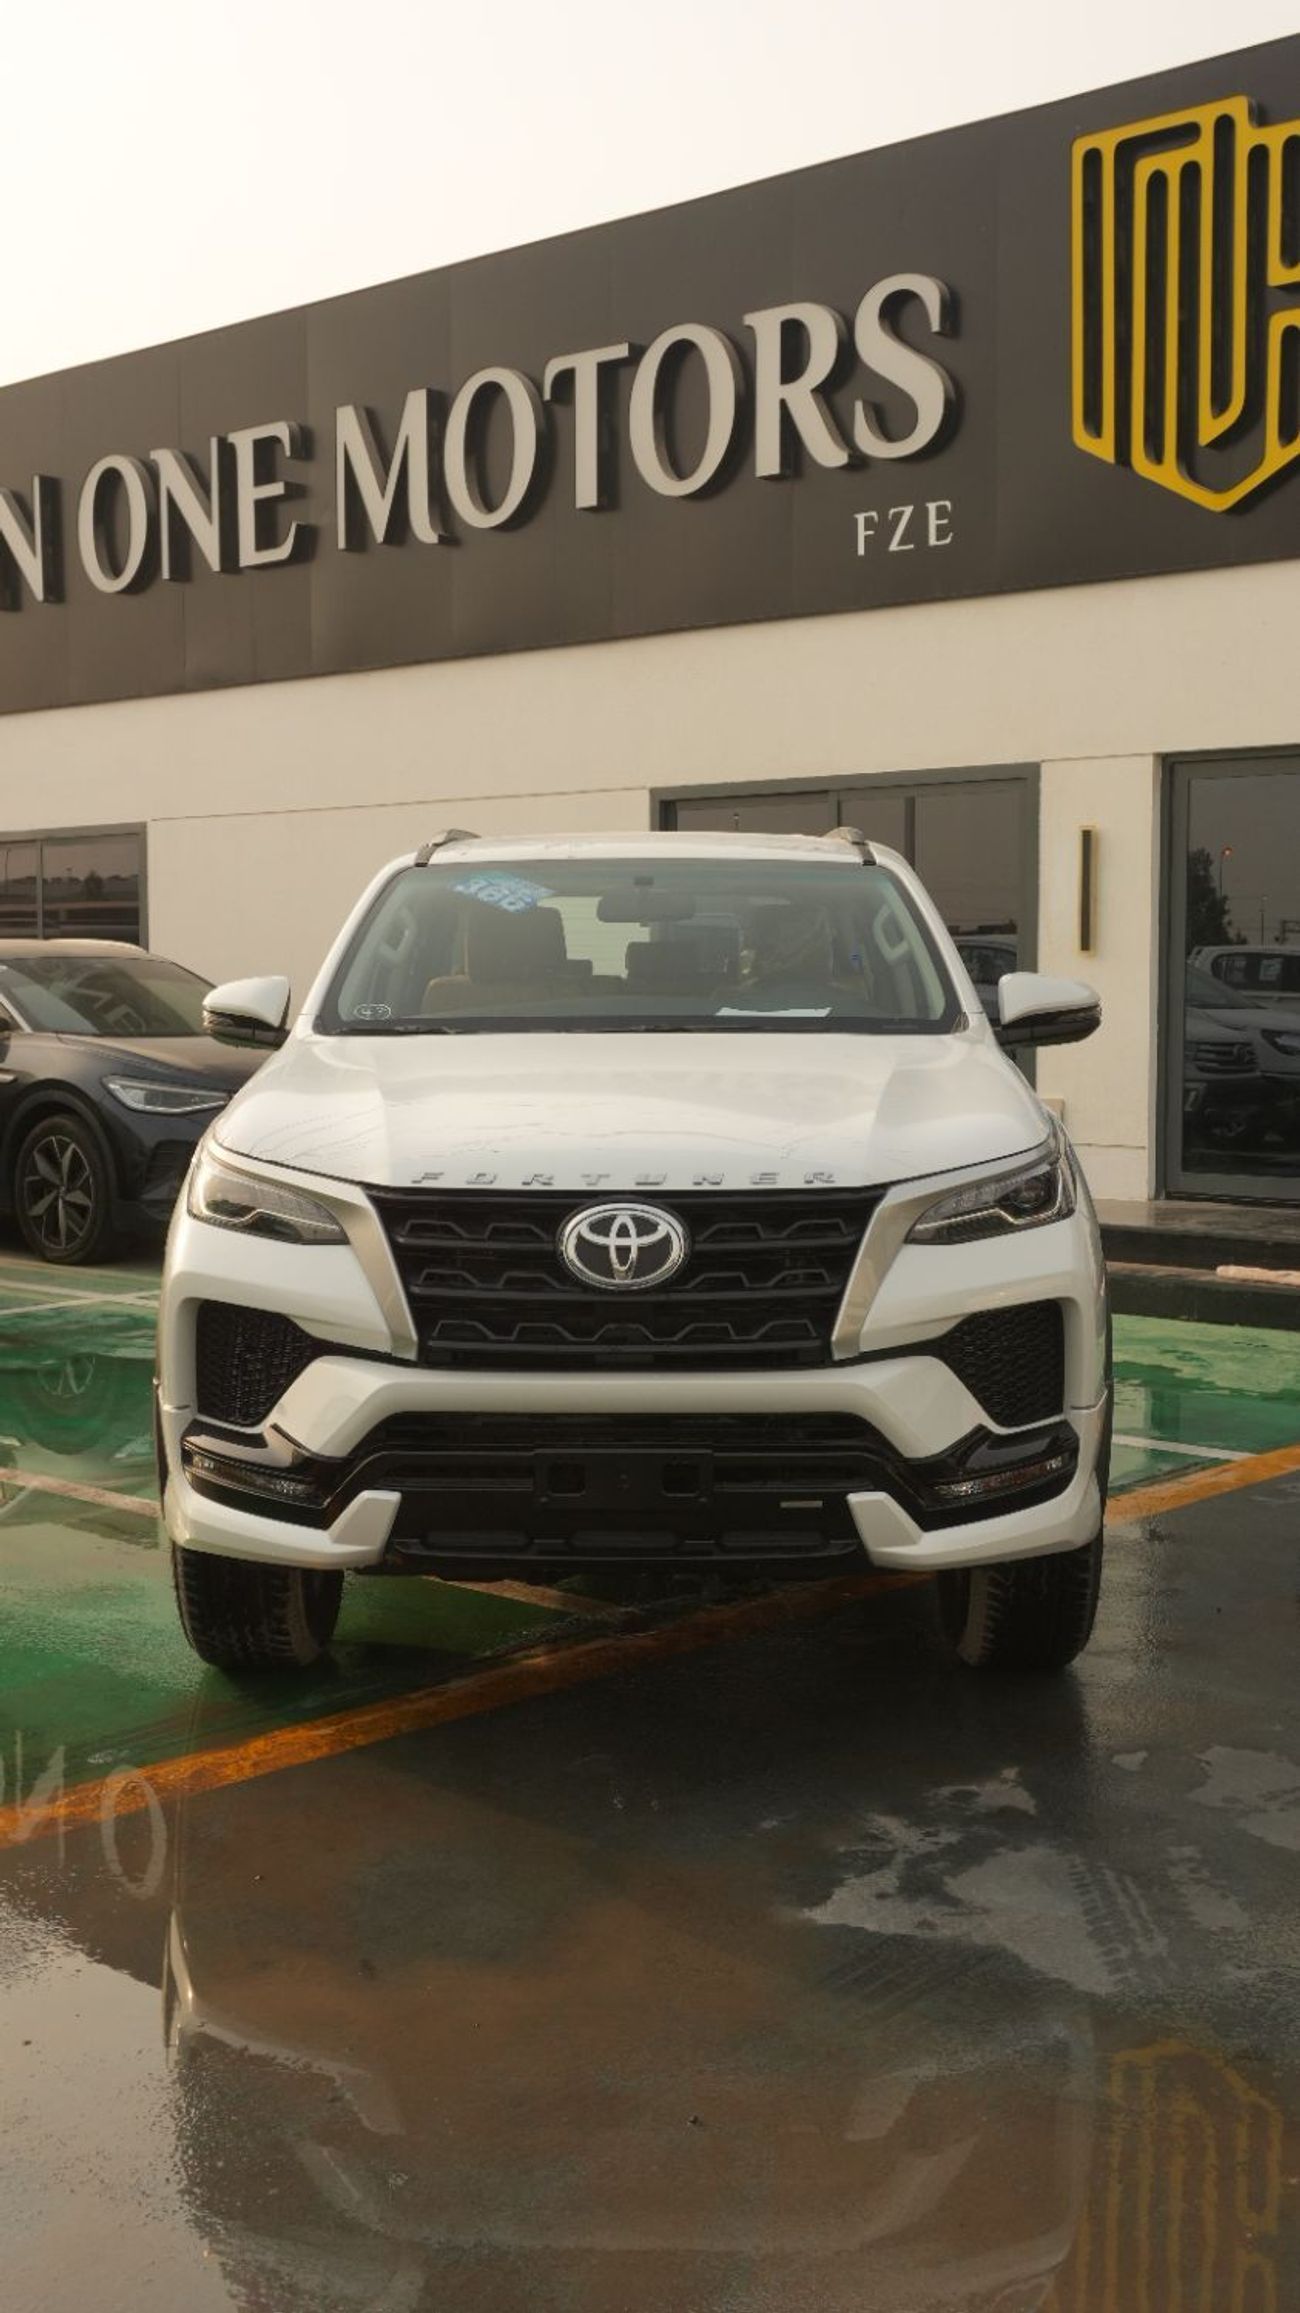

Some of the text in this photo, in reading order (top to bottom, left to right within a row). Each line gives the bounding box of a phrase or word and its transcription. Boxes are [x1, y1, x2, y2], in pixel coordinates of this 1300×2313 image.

[78, 420, 304, 594] ONE
[337, 273, 958, 551] MOTORS
[853, 500, 953, 556] FZE
[411, 1171, 838, 1187] FORTUNER
